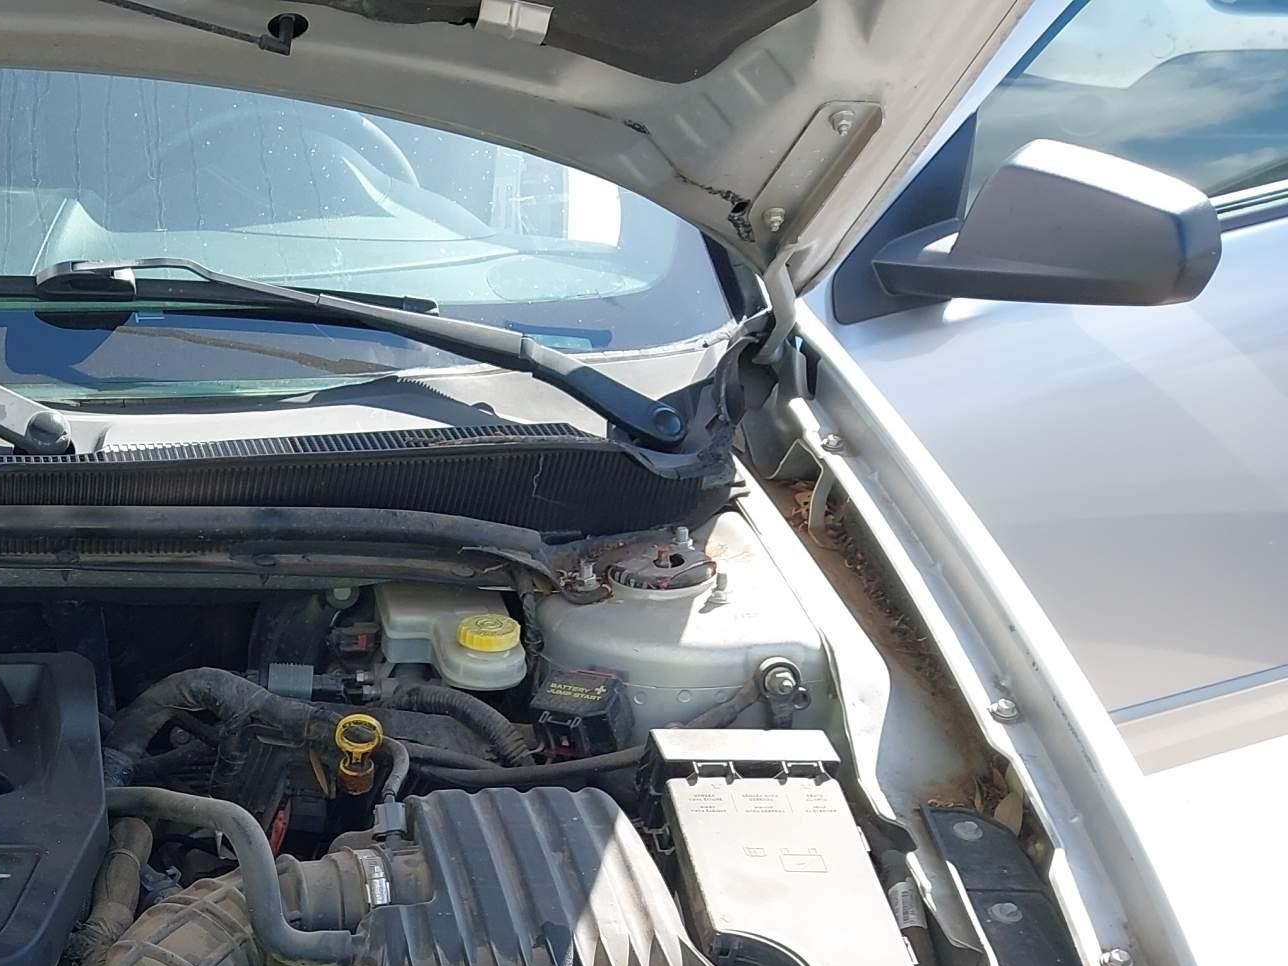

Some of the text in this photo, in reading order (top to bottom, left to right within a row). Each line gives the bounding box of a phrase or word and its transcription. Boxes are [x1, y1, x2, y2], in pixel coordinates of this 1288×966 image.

[550, 682, 590, 693] BATTERY
[546, 688, 602, 701] JUMP START
